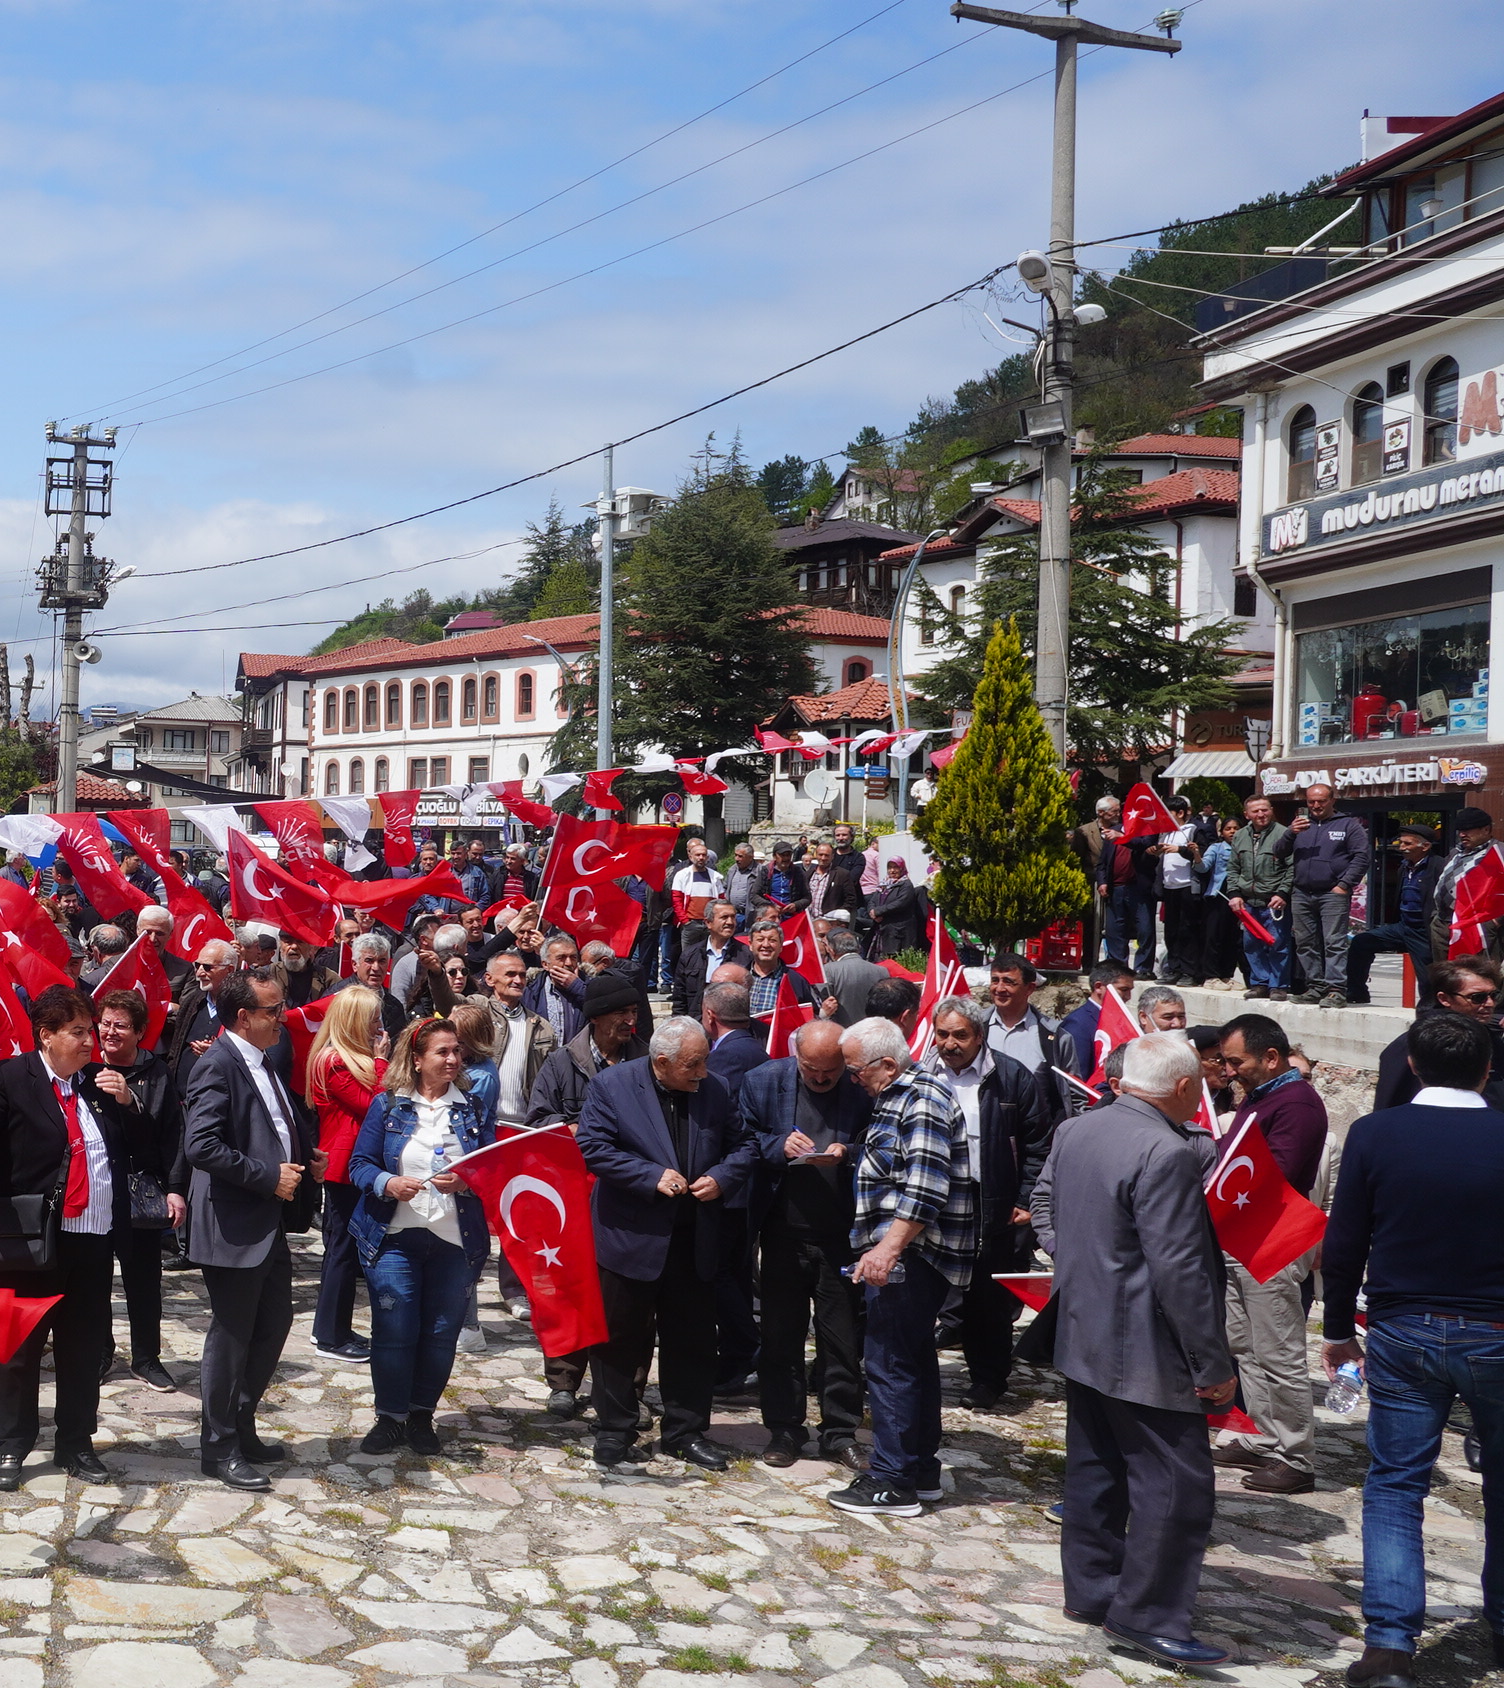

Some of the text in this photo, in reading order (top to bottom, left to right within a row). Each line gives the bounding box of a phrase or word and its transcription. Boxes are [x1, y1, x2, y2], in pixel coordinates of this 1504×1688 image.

[1322, 484, 1439, 534] mudurnu
[1295, 756, 1439, 790] ADA ŞARKÜTERİ
